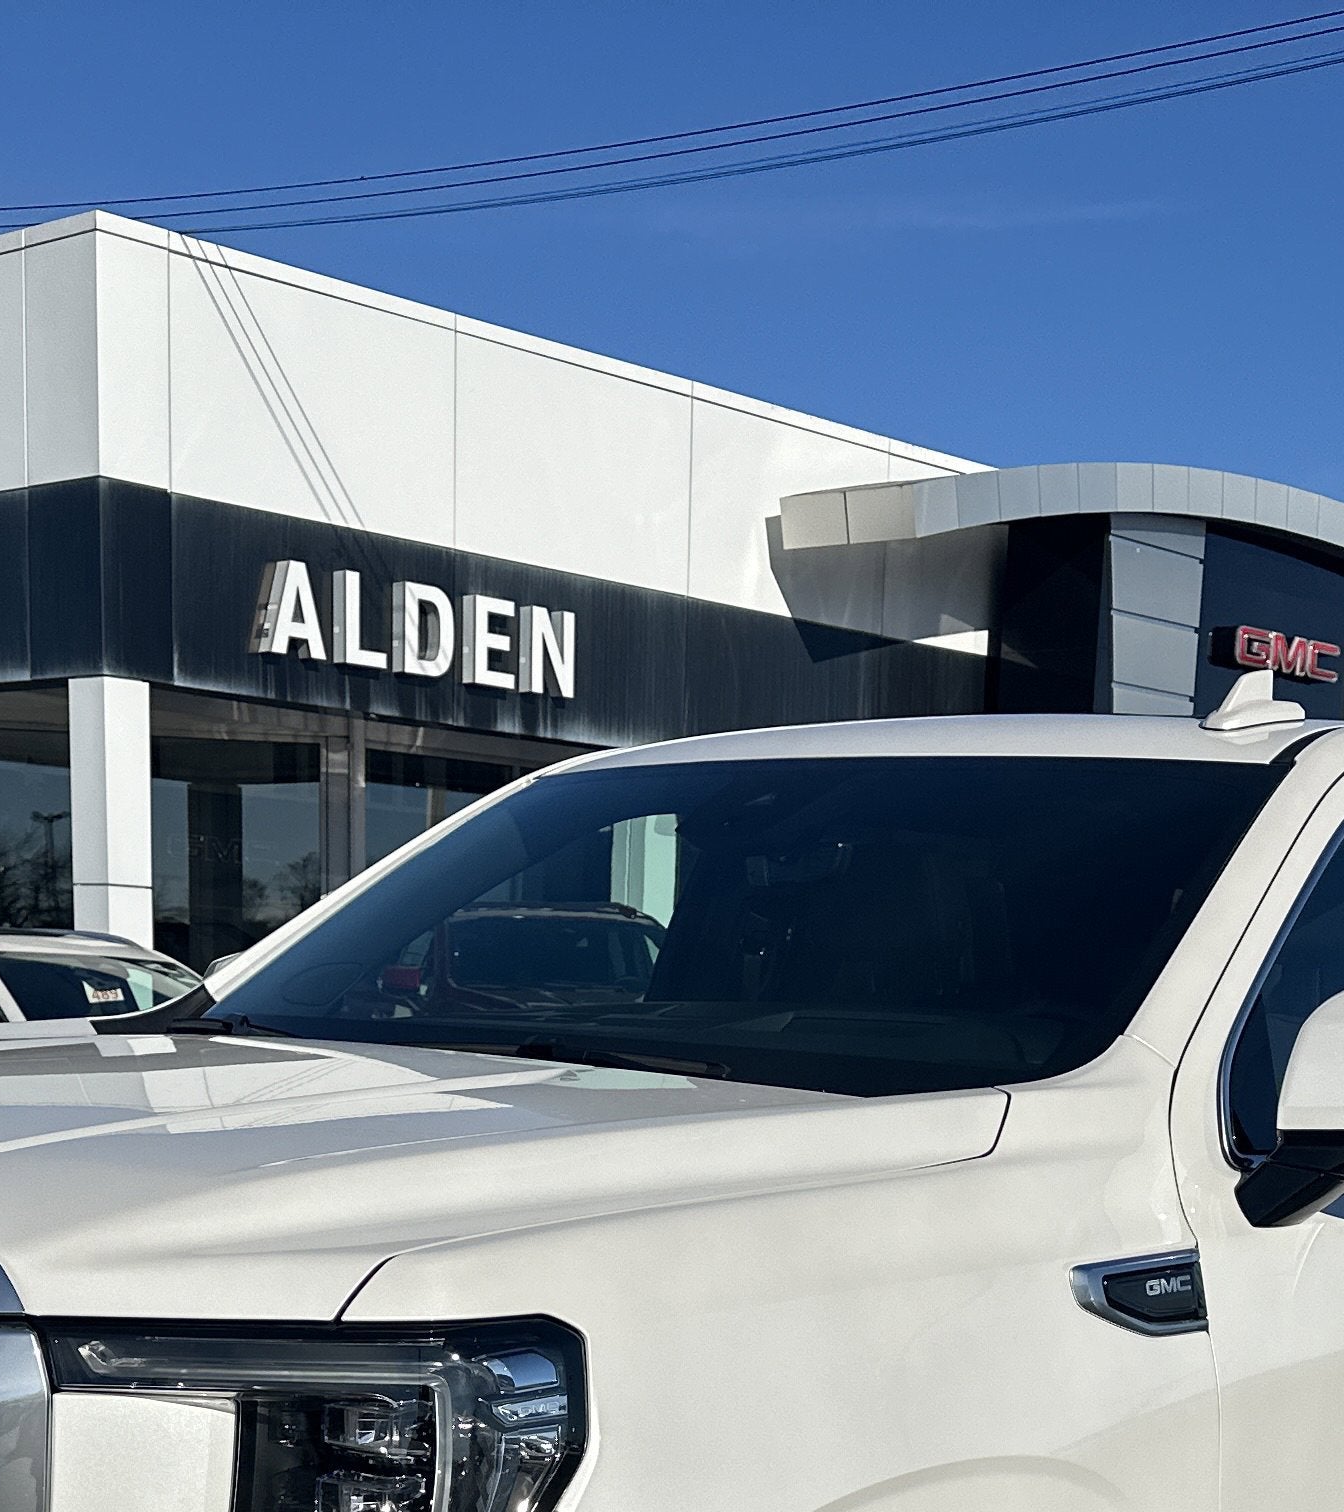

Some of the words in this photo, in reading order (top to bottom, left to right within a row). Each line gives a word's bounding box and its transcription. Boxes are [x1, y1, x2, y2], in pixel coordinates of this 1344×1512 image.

[259, 558, 576, 699] ALDEN
[1235, 625, 1341, 683] GMC
[1145, 1275, 1192, 1296] GMC
